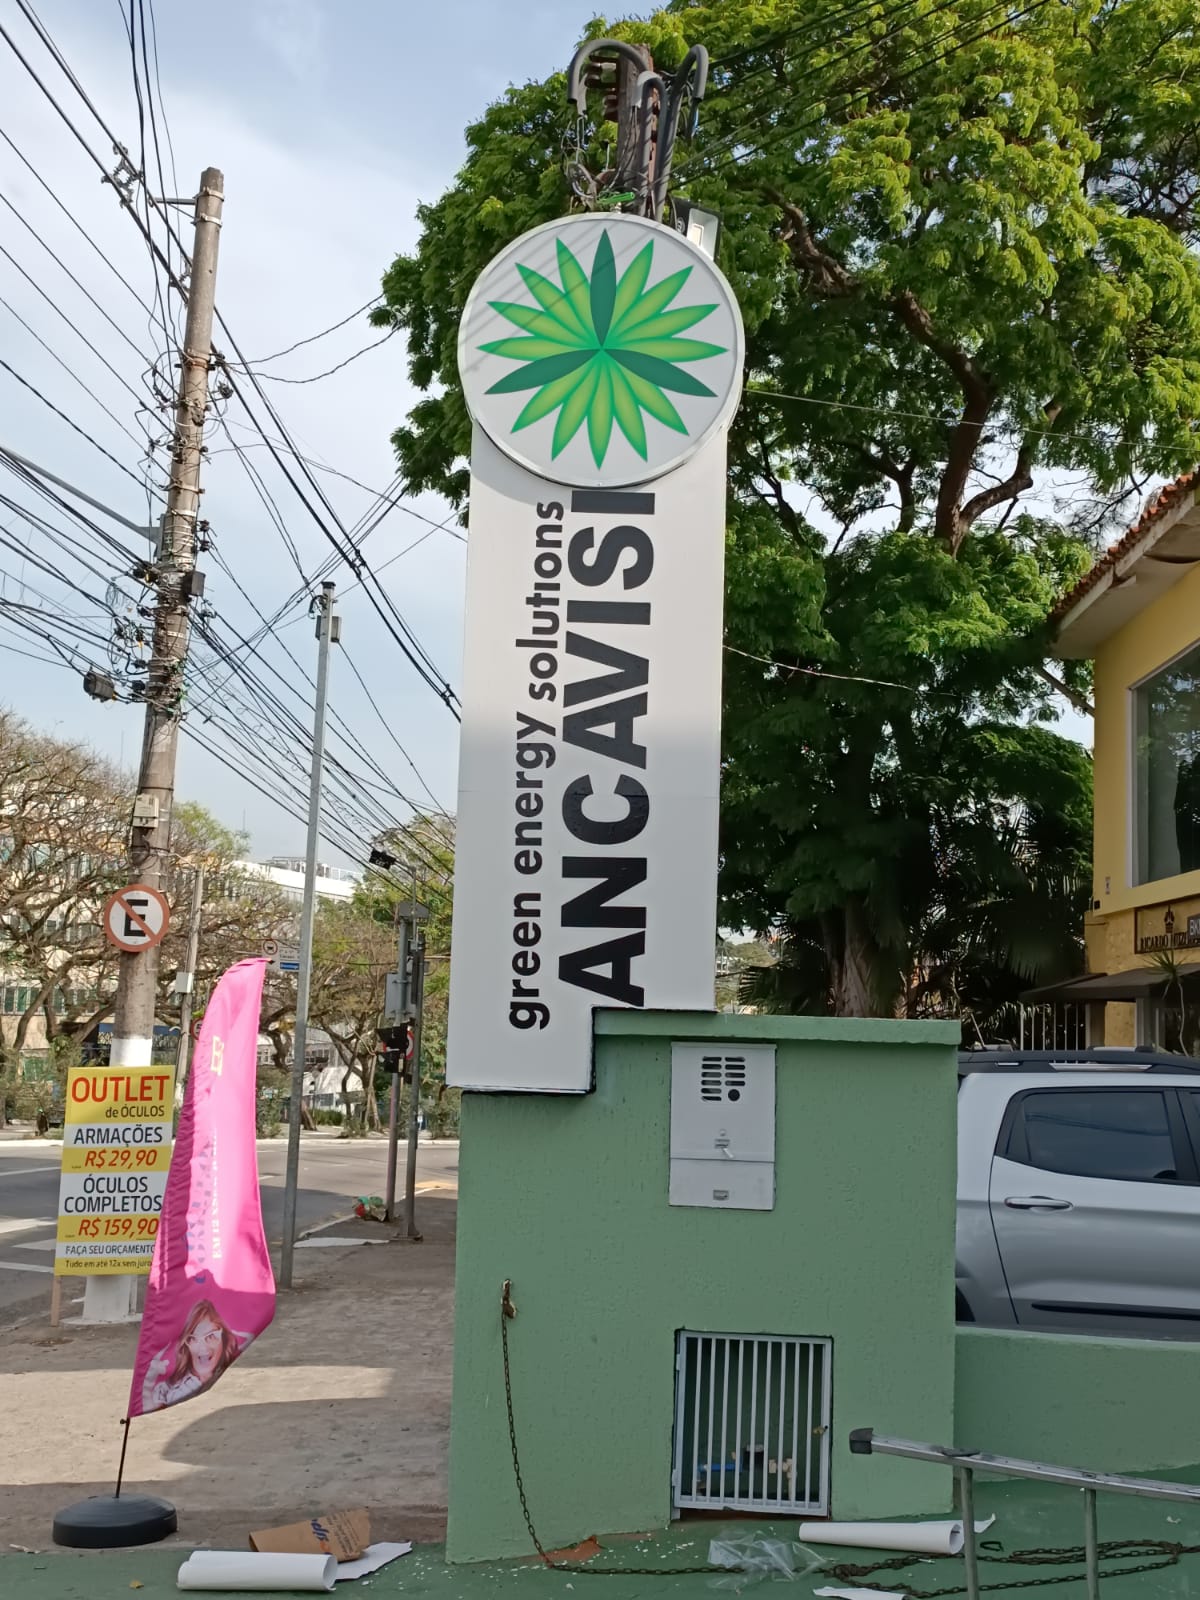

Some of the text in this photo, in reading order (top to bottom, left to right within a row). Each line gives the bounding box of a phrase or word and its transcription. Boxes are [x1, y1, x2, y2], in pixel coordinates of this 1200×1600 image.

[558, 490, 655, 1006] ANCAVISI
[509, 501, 564, 1030] green energy solutions
[124, 899, 149, 937] E
[71, 1075, 171, 1103] OUTLET
[105, 1105, 165, 1118] de ÓCULOS
[73, 1124, 163, 1147] ARMAÇÕES
[83, 1174, 148, 1194] ÓCULOS
[64, 1195, 162, 1213] COMPLETOS
[65, 1245, 87, 1256] FAÇA
[88, 1245, 104, 1254] SEU
[65, 1259, 83, 1268] Tudo
